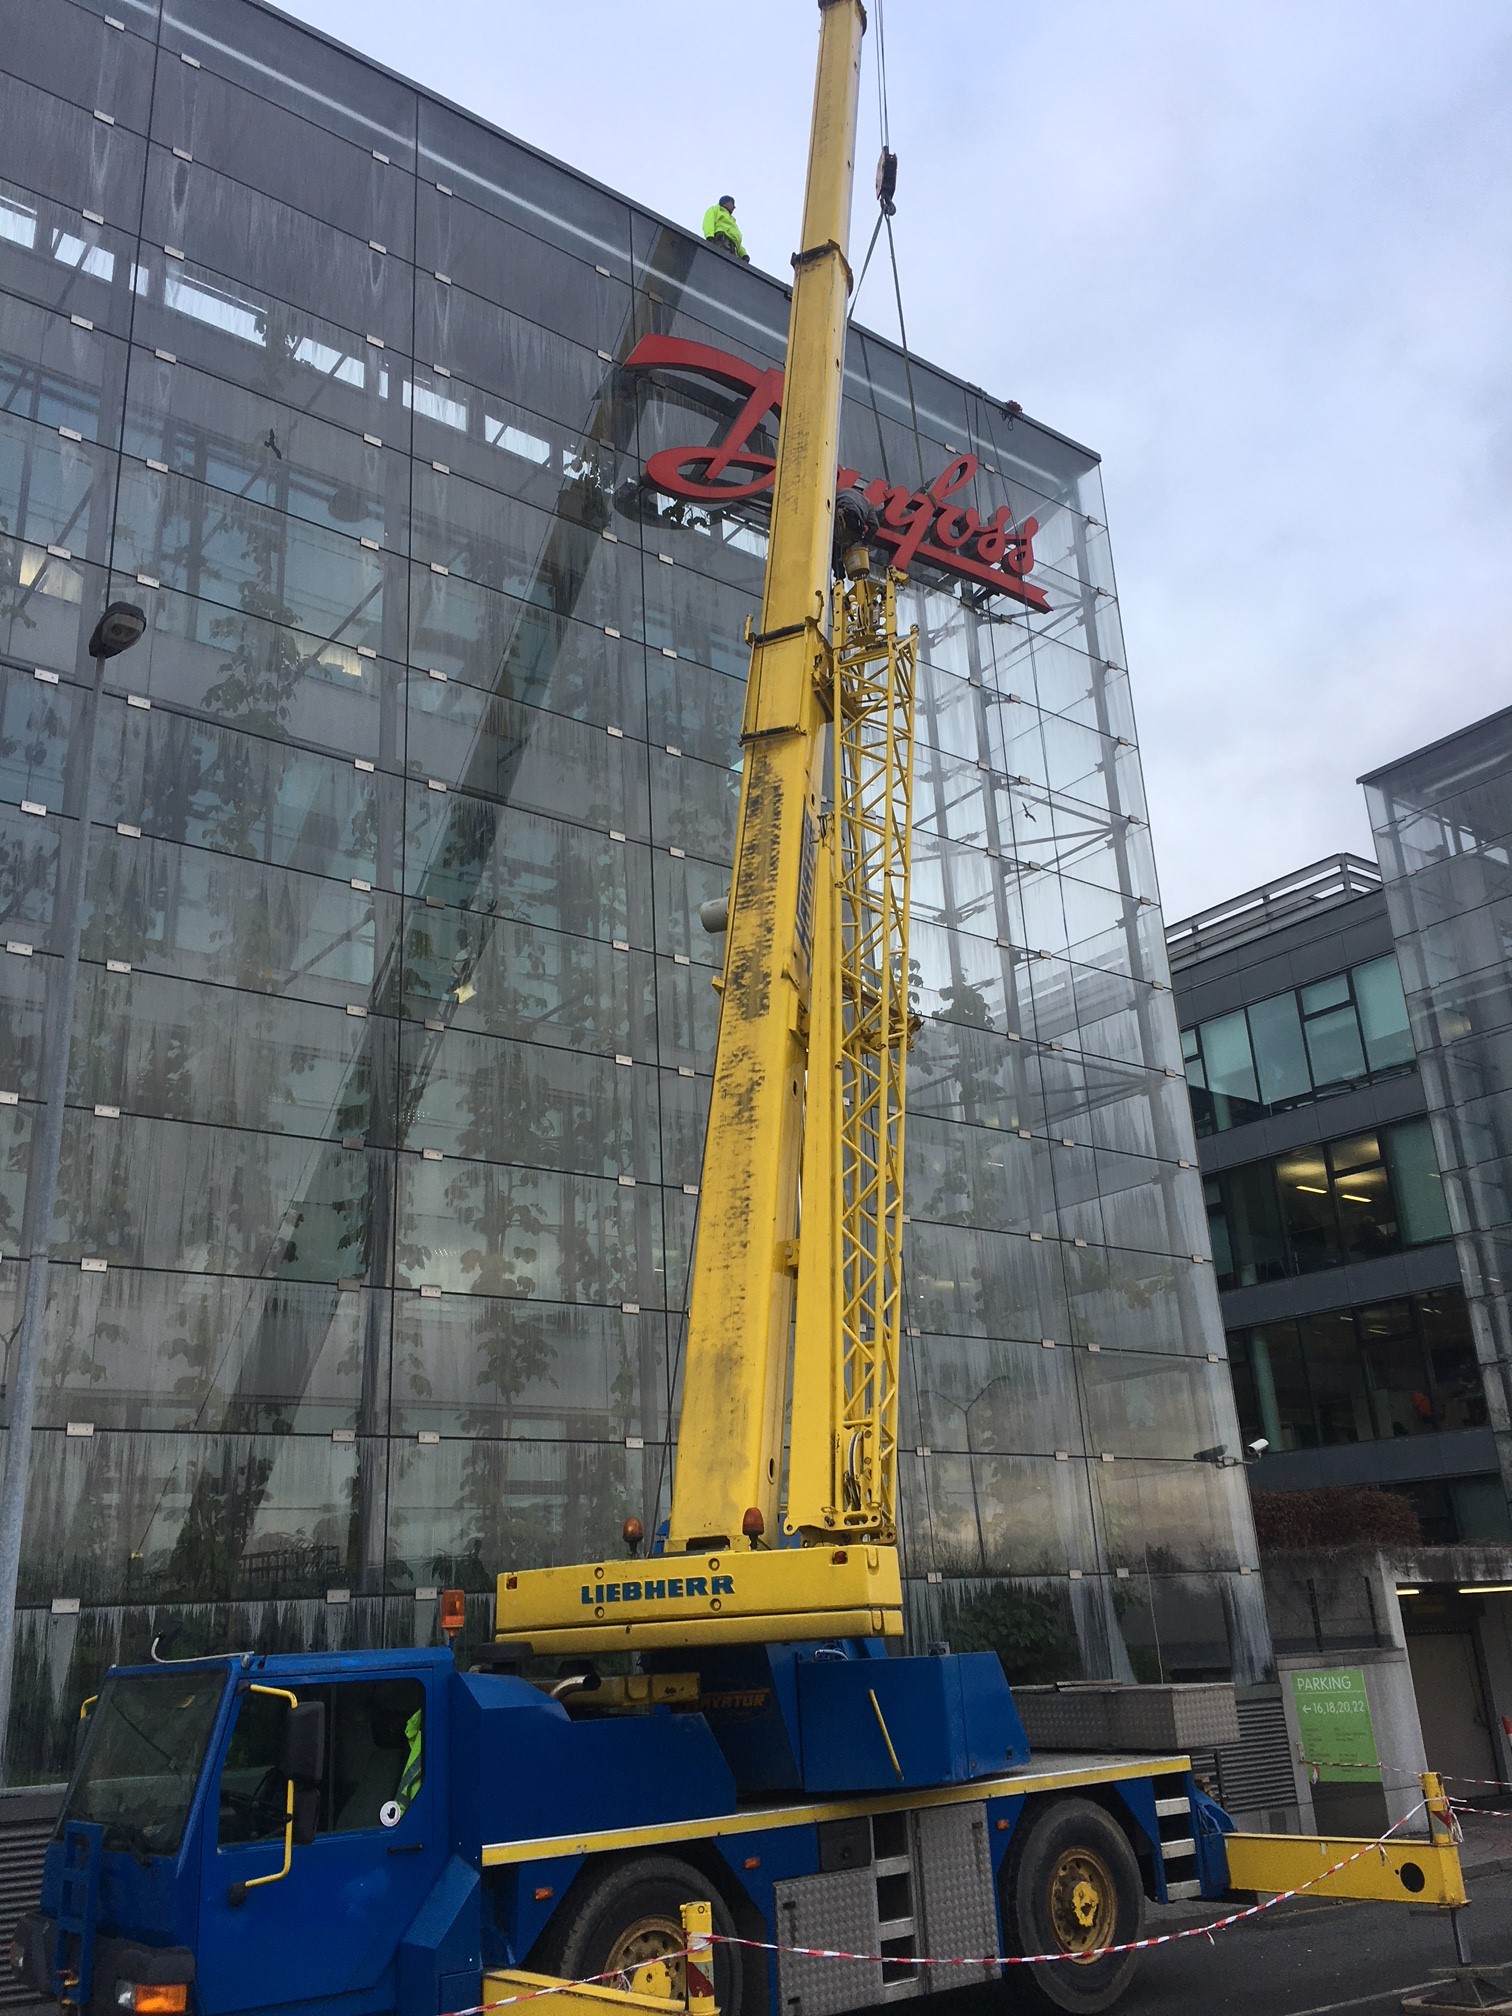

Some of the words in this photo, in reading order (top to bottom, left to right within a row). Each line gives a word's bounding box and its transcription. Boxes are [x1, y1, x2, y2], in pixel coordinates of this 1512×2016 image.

[622, 333, 1053, 613] Dnfoss
[581, 1575, 736, 1604] LIEBHERR
[1297, 1676, 1352, 1691] PARKING
